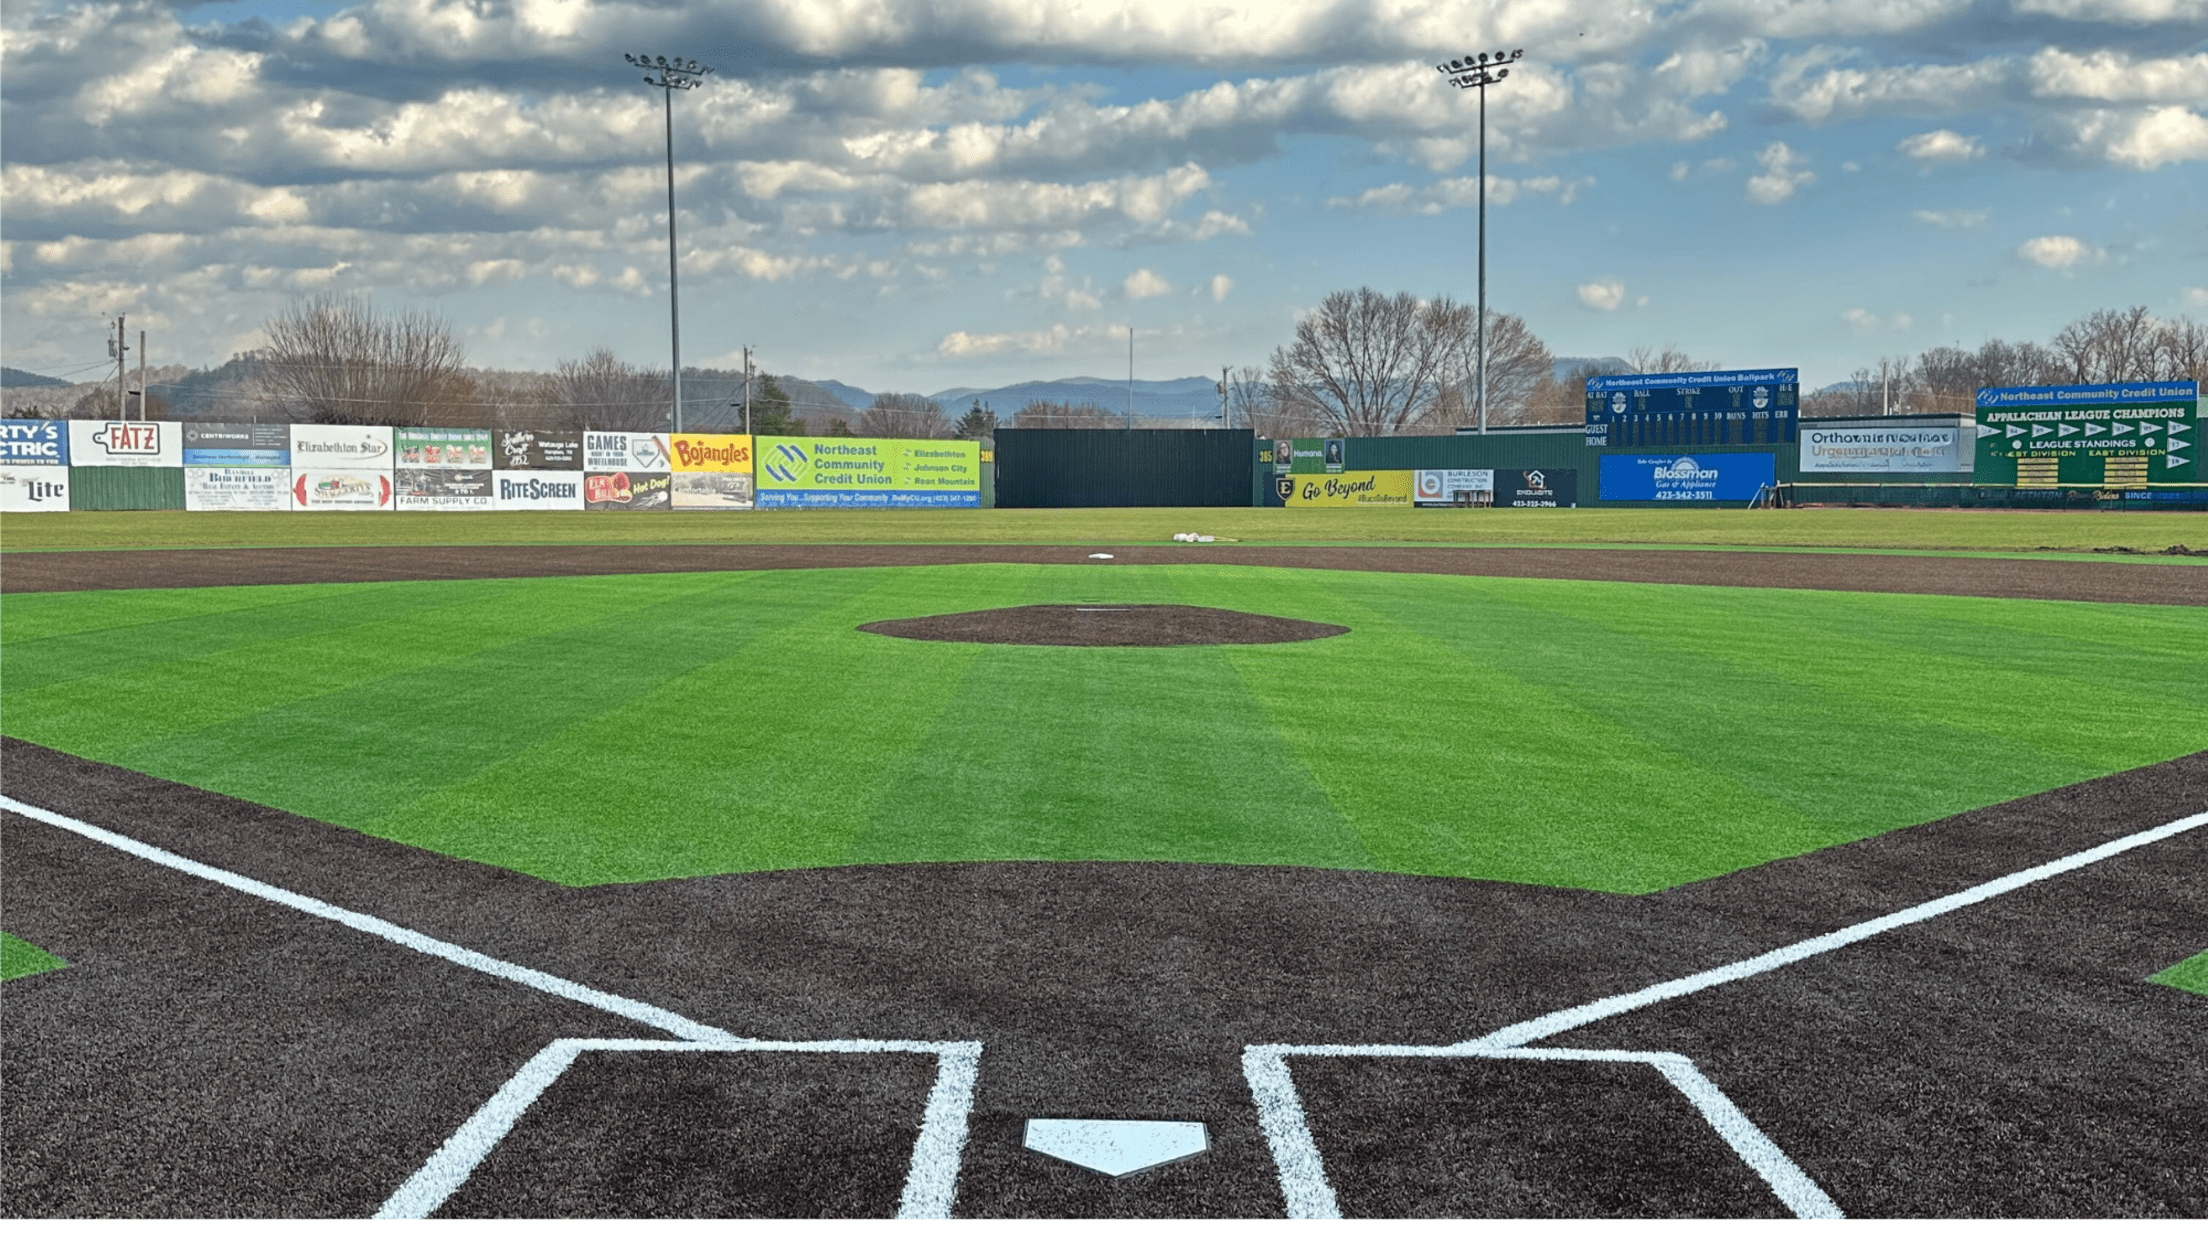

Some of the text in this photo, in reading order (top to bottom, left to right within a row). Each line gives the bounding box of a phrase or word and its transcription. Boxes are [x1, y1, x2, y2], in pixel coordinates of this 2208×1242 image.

[1605, 372, 1775, 386] Northeast Community Credit Union Ballpark
[1634, 389, 1650, 397] BALL
[1677, 387, 1700, 396] STRIKE
[2000, 386, 2193, 401] Northeast Community Credit Union
[1726, 412, 1746, 420] RUNS
[1752, 411, 1769, 419] HITS
[1775, 410, 1788, 418] ERR
[1987, 408, 2185, 422] APPALACHIAN LEAGUE CHAMPIONS
[1585, 424, 1608, 434] GUEST
[111, 422, 154, 449] FATZ
[1585, 436, 1607, 446] HOME
[297, 440, 382, 454] Elizabethton Star
[587, 435, 627, 451] GAMES
[2029, 440, 2136, 449] LEAGUE STANDINGS
[674, 439, 749, 467] Bojangles
[814, 444, 877, 455] Northeast
[2118, 448, 2165, 456] DIVISION
[814, 458, 885, 473] Community
[914, 463, 967, 473] Johnson City
[1653, 466, 1718, 479] Blossman
[814, 473, 892, 485] Credit Union
[915, 477, 975, 485] Roan Mountain
[1656, 480, 1670, 488] Gas
[1680, 481, 1717, 490] Appliance
[28, 480, 64, 502] Lite
[633, 482, 649, 494] Hot
[1280, 481, 1291, 494] E
[1302, 475, 1376, 500] Go Beyond
[400, 497, 487, 505] FARM SUPPLY CO
